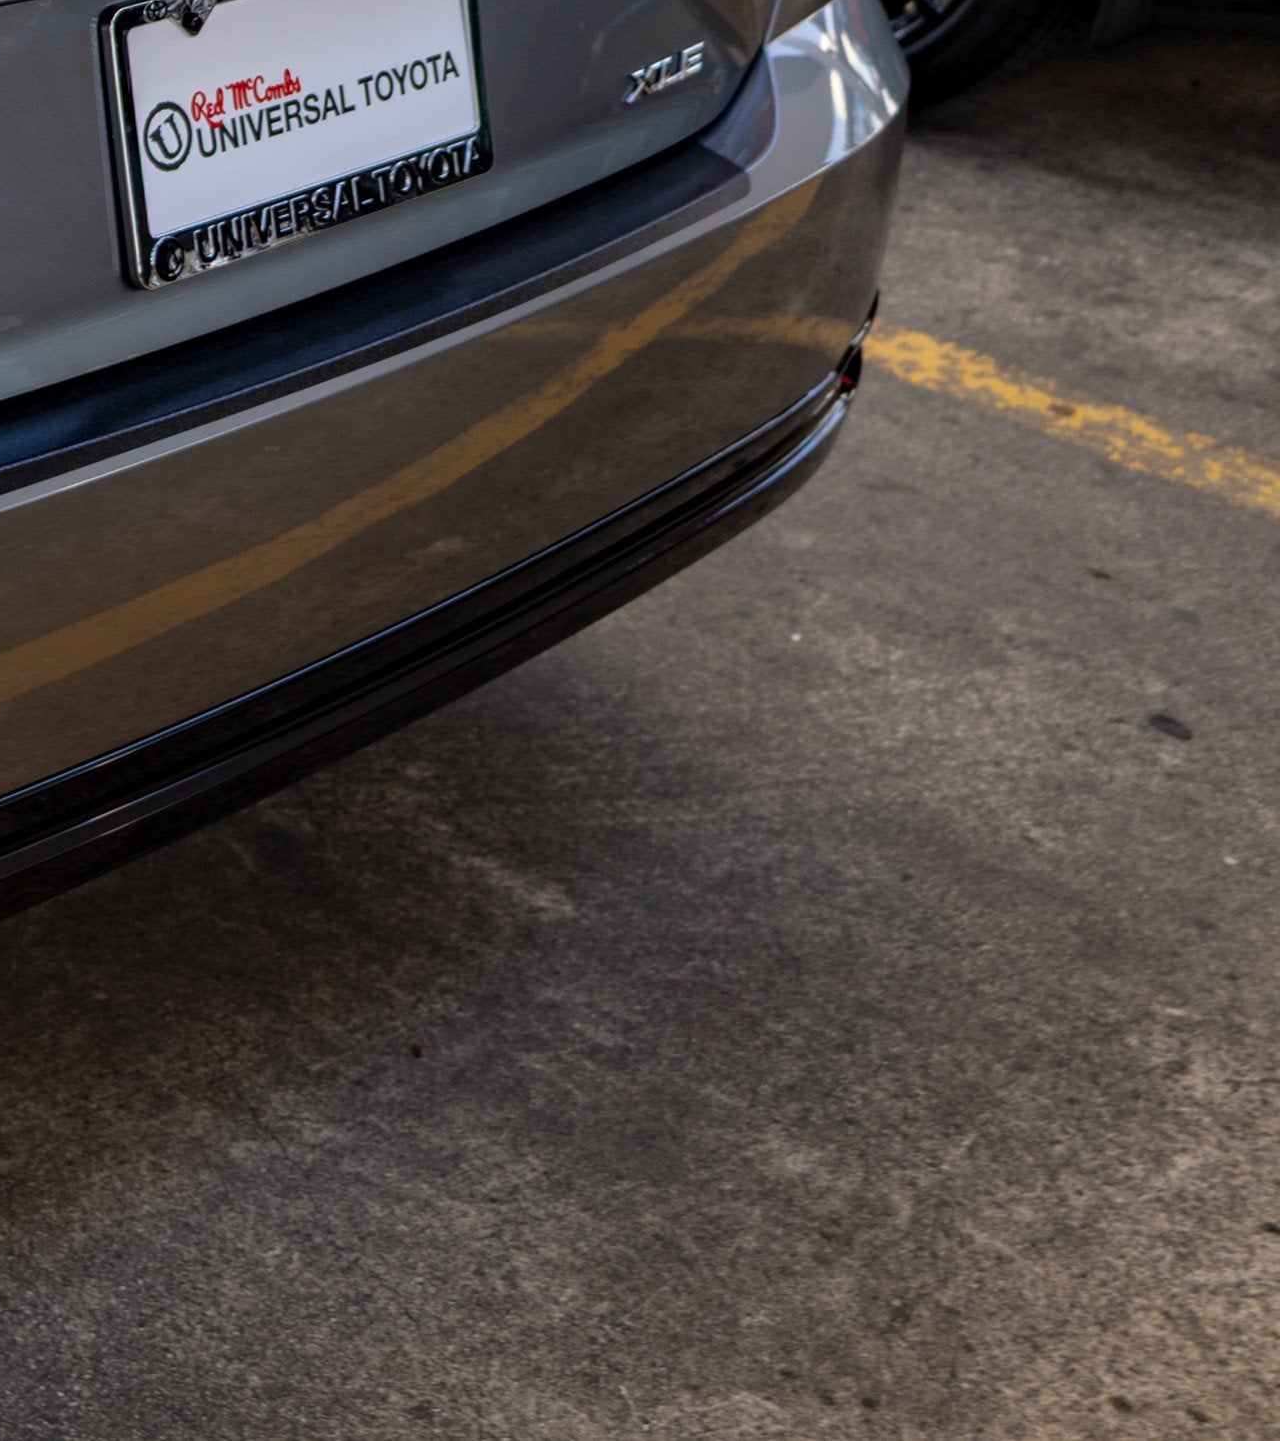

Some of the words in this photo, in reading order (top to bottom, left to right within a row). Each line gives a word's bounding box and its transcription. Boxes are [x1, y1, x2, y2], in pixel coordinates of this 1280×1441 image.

[190, 86, 226, 129] Red
[223, 67, 302, 112] McCombs
[196, 84, 357, 159] UNIVERSAL
[357, 50, 461, 108] TOYOTA
[623, 40, 706, 104] XLE
[192, 174, 375, 264] UNIVERSAL
[370, 135, 482, 205] TOYOTA
